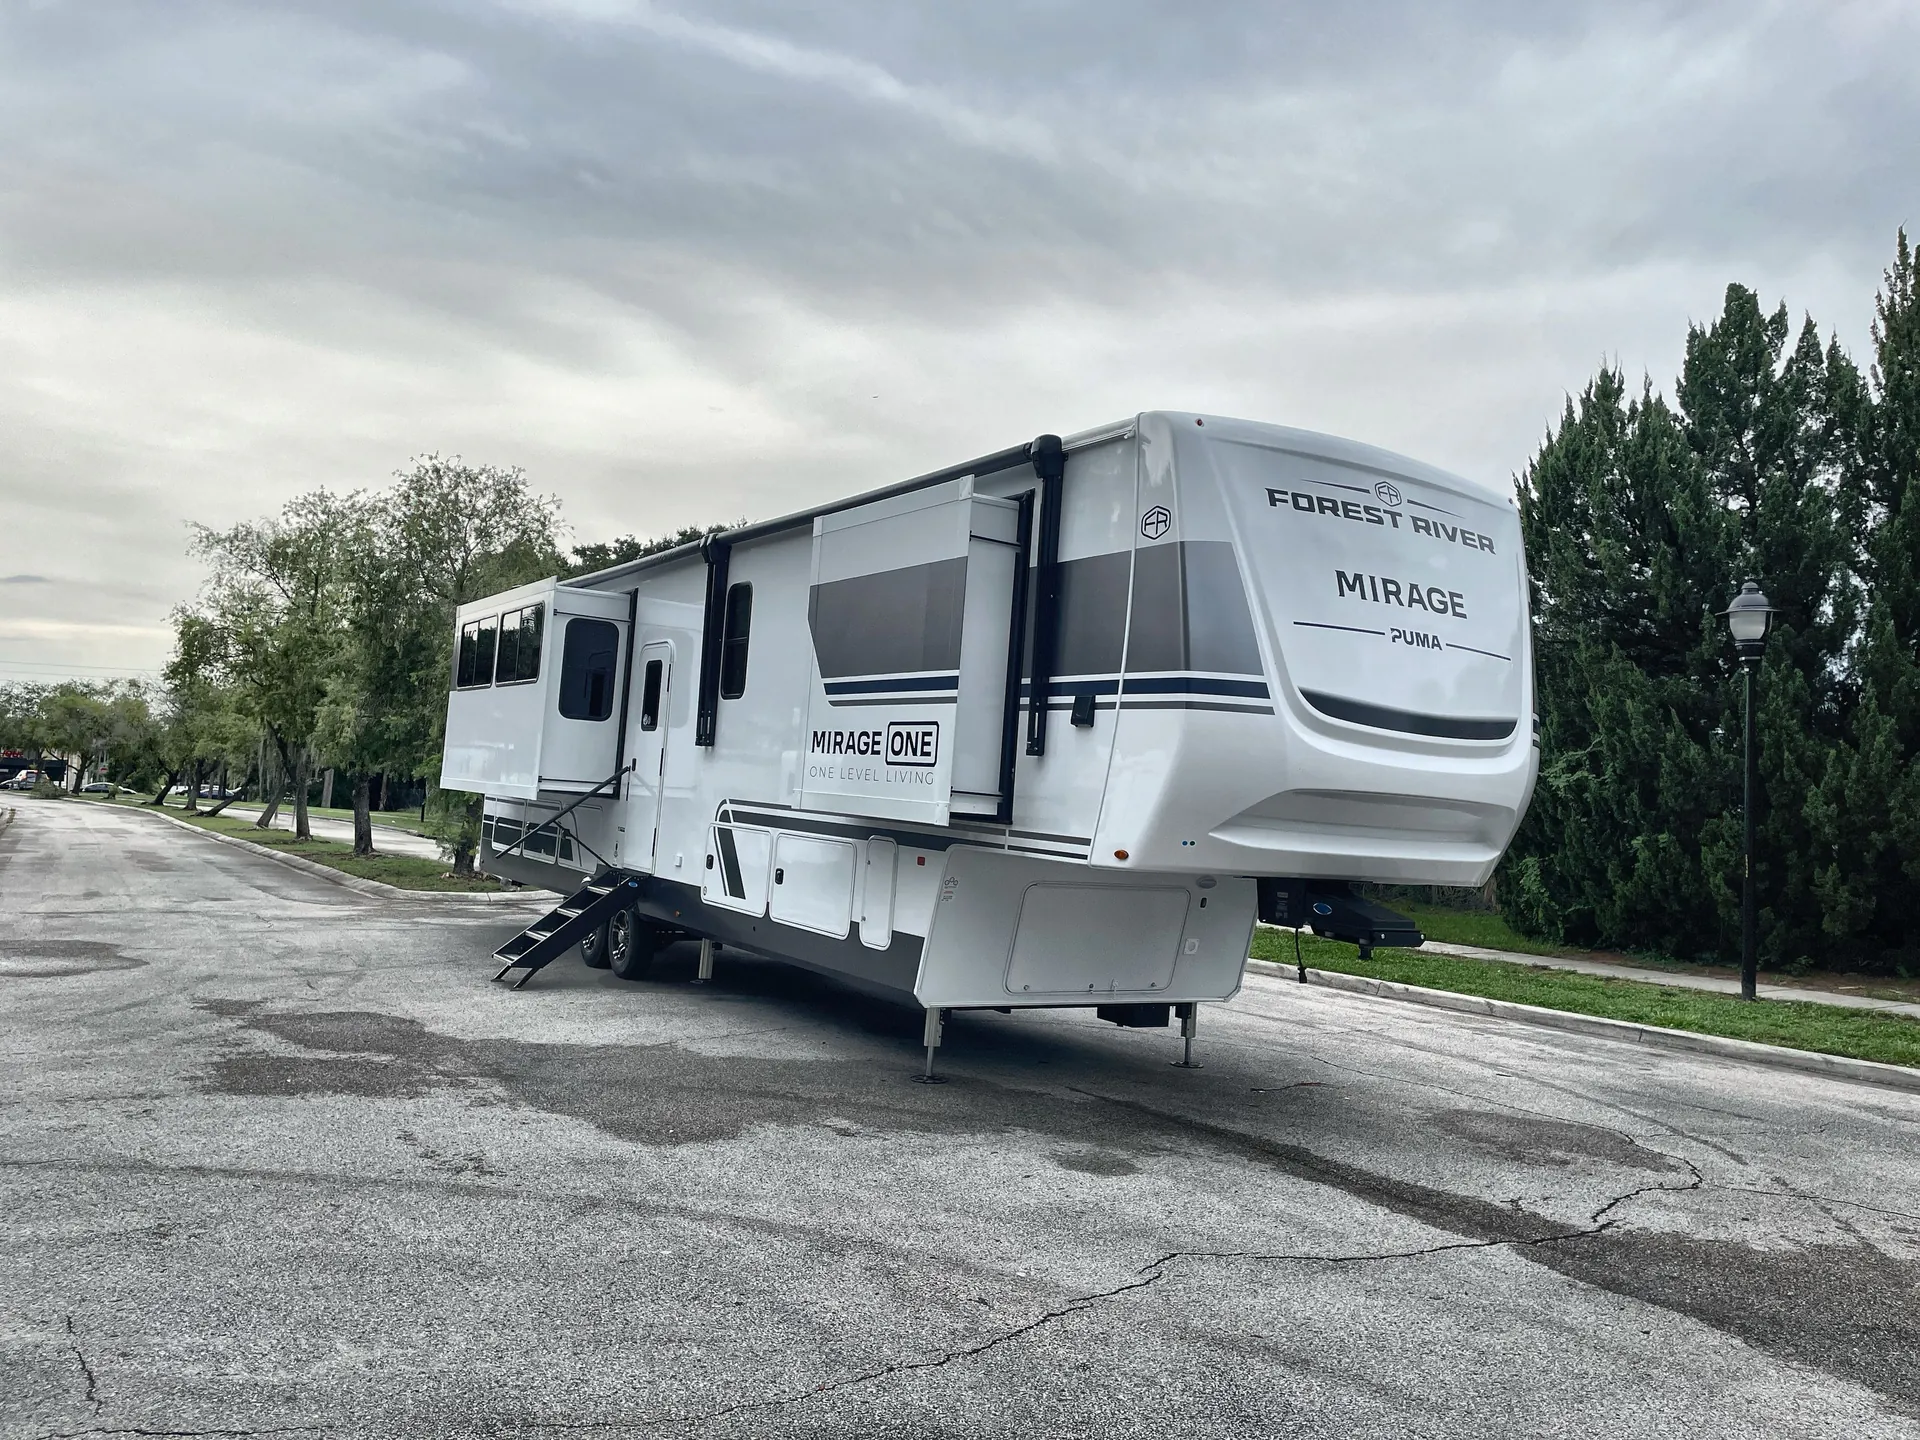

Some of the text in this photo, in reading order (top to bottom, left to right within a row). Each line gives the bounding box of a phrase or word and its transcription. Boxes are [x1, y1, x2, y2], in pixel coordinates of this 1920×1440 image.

[1265, 488, 1496, 554] FOREST RIVER
[1335, 570, 1467, 619] MIRAGE
[1390, 628, 1443, 650] PUMA
[811, 730, 933, 756] MIRAGE ONE
[809, 766, 934, 785] ONE LEVEL LIVING
